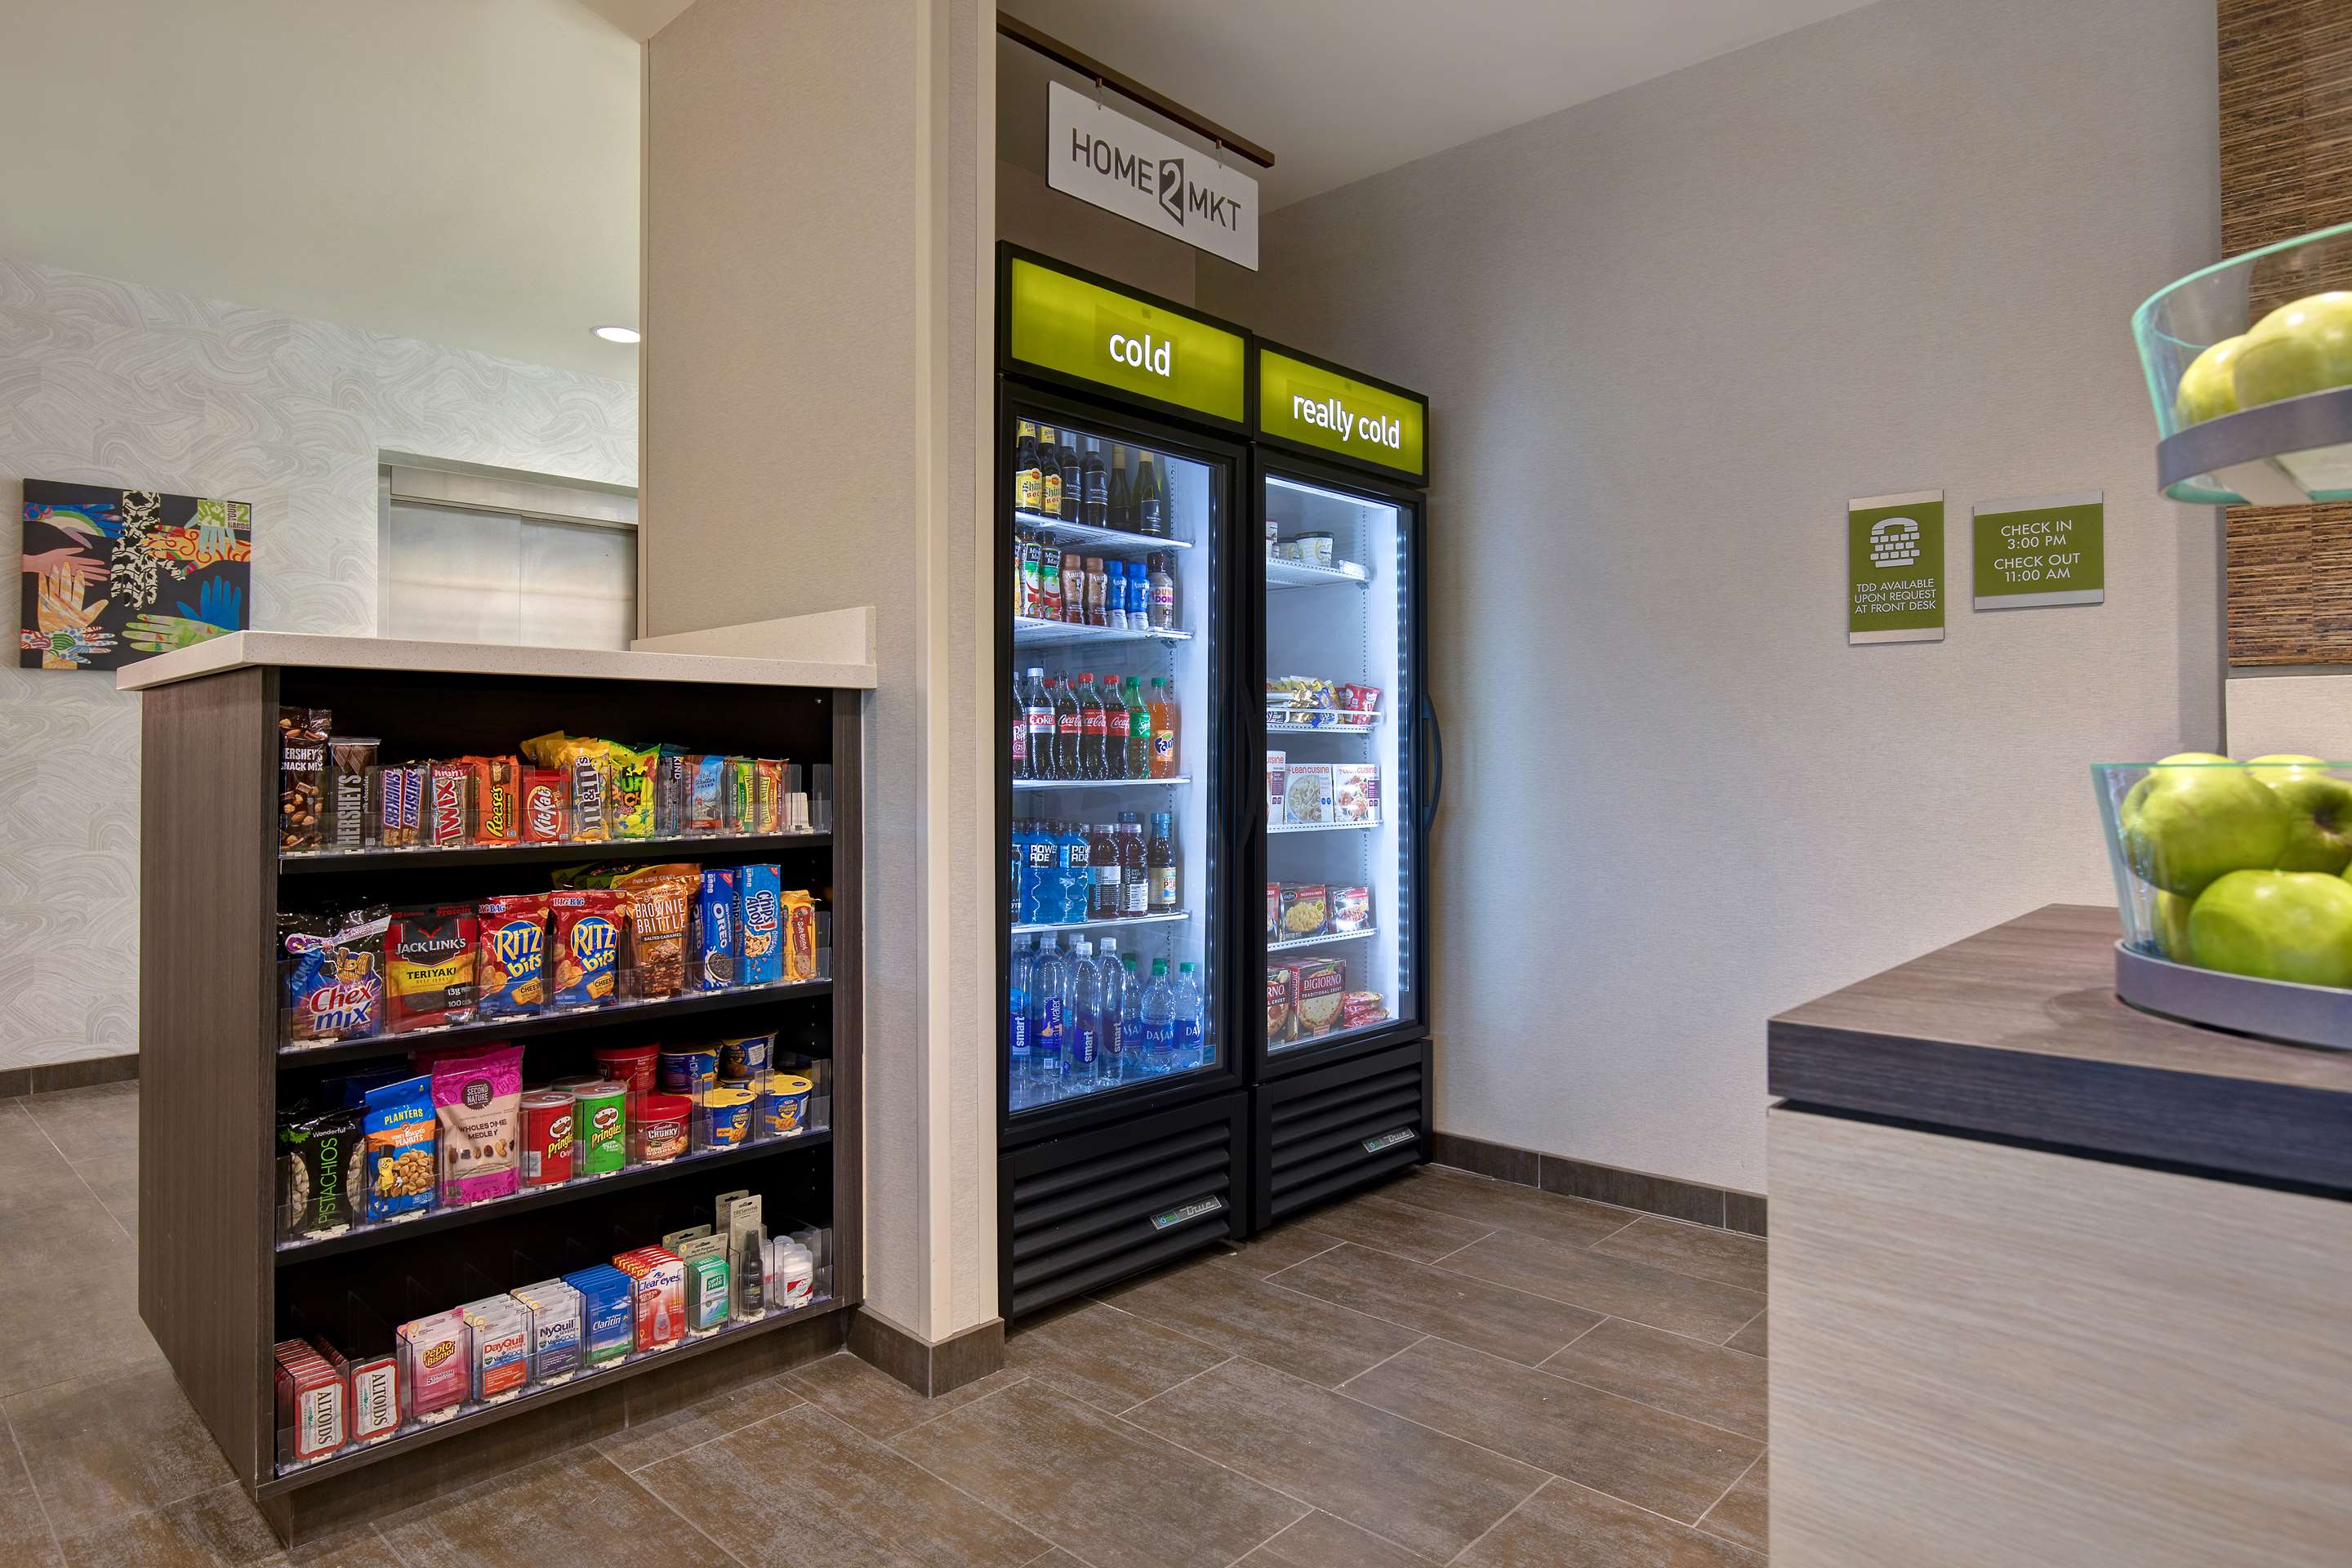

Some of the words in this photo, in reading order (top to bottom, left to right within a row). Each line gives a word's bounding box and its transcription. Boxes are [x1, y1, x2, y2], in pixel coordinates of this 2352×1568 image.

[1071, 127, 1153, 195] HOME
[1189, 181, 1241, 231] MKT
[1109, 333, 1171, 377] cold
[1293, 394, 1353, 441] really
[1358, 414, 1401, 449] cold
[237, 505, 249, 523] 2
[2001, 523, 2051, 537] CHECK
[2056, 520, 2072, 531] IN
[2007, 537, 2039, 550] 3:00
[2046, 535, 2066, 546] PM
[1994, 555, 2043, 570] CHECK
[2048, 553, 2080, 565] OUT
[1856, 582, 1877, 592] TDD
[1880, 578, 1934, 590] AVAILABLE
[2005, 570, 2040, 582] 11:00
[2046, 568, 2070, 580] AM
[1855, 593, 1886, 604] UPON
[1890, 589, 1936, 602] REQUEST
[1855, 604, 1868, 614] AT
[1871, 602, 1905, 612] FRONT
[1909, 600, 1936, 611] DESK
[1030, 715, 1053, 724] Coke
[308, 762, 323, 771] MIX
[385, 770, 401, 828] SNICKERS
[404, 770, 422, 828] SATISFIES
[337, 775, 361, 844] HERSHEY'S
[435, 780, 462, 846] TWIX
[486, 786, 504, 837] Reese's
[635, 898, 684, 920] BROWNIE
[756, 891, 773, 923] Chips
[638, 914, 685, 934] BRITTLE
[713, 902, 728, 948] OREO
[395, 942, 428, 955] JACK
[429, 938, 466, 951] LINK'S
[497, 926, 541, 962] RITZ
[573, 924, 614, 957] RITZ
[507, 954, 541, 978] bits
[582, 950, 615, 973] bits
[407, 967, 457, 980] TERIYAKI
[311, 980, 375, 1013] Chex
[448, 988, 461, 996] 13g
[1302, 989, 1330, 999] TRADITIONAL
[315, 1001, 372, 1031] mix
[1014, 1016, 1025, 1046] smart
[1114, 1021, 1122, 1053] smart
[1084, 1030, 1093, 1062] smart
[467, 1085, 488, 1096] SECOND
[467, 1094, 488, 1103] NATURE
[385, 1108, 424, 1125] PLANTERS
[459, 1119, 508, 1133] WHOLESOME
[313, 1127, 346, 1138] Wonderful
[395, 1134, 424, 1146] PEANUTS
[468, 1129, 498, 1140] MEDLEY
[591, 1124, 621, 1150] Pringles
[648, 1128, 678, 1138] CHUNKY
[318, 1138, 337, 1224] PISTACHIOS
[660, 1274, 680, 1285] eyes
[540, 1320, 574, 1339] NyQuil
[593, 1316, 621, 1331] Claritin
[484, 1334, 524, 1354] DayQuil
[427, 1347, 455, 1368] Bismol
[427, 1377, 432, 1385] 5
[372, 1374, 388, 1426] ALTOIDS
[318, 1392, 332, 1445] ALTOIDS
